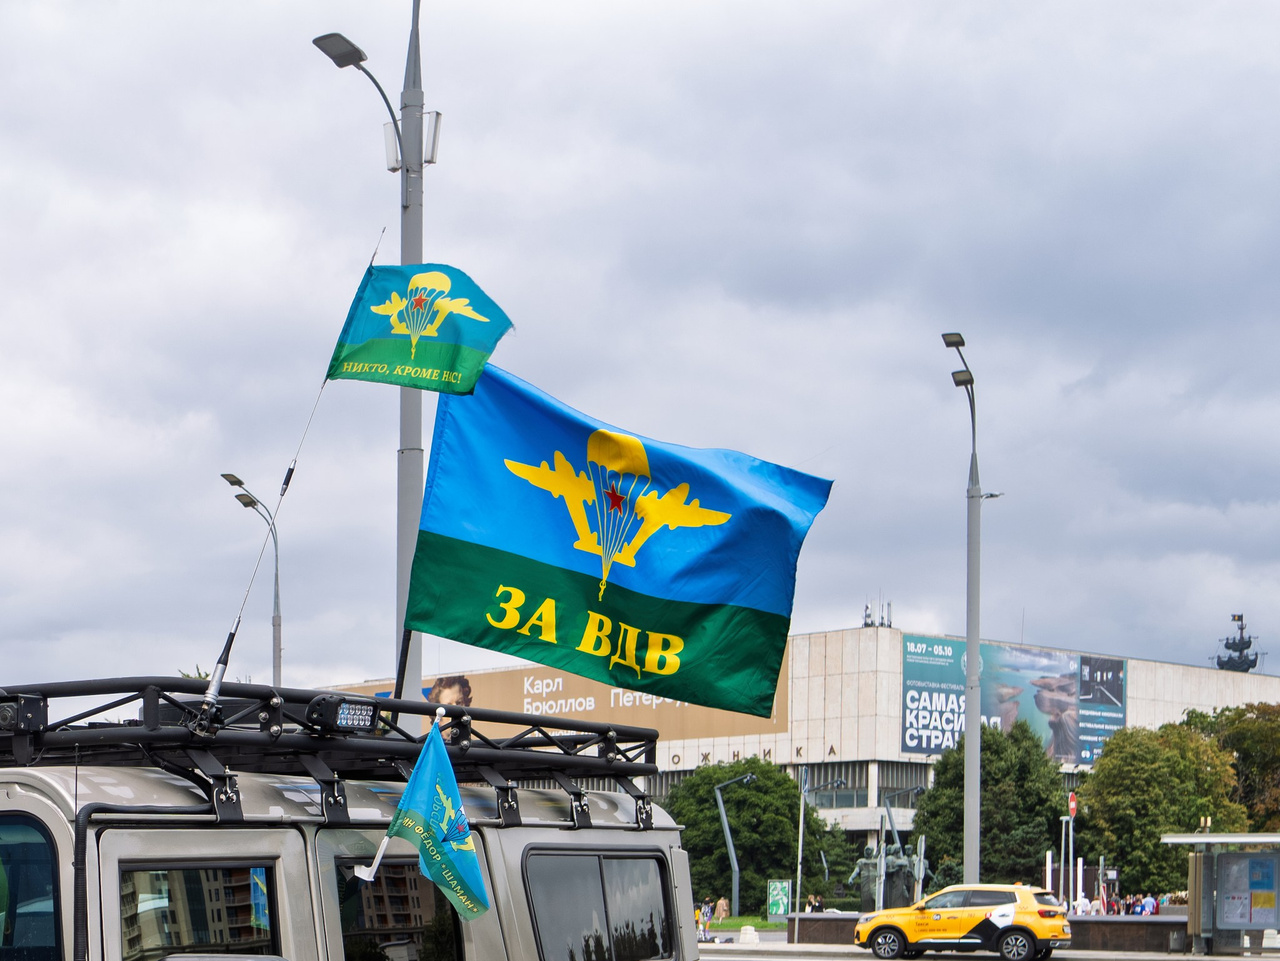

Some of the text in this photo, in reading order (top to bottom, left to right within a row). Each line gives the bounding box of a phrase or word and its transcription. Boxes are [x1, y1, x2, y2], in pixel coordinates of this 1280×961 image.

[342, 362, 390, 376] НИКТО,
[393, 365, 440, 380] КРОМЕ
[485, 584, 685, 680] ЗА ВДВ
[906, 641, 927, 654] 18.07
[933, 645, 953, 657] 05.10
[523, 676, 563, 698] Карл
[523, 695, 596, 715] Брюллов
[905, 708, 1002, 732] КРАСИАЯ
[671, 744, 837, 766] ОЖНИКА
